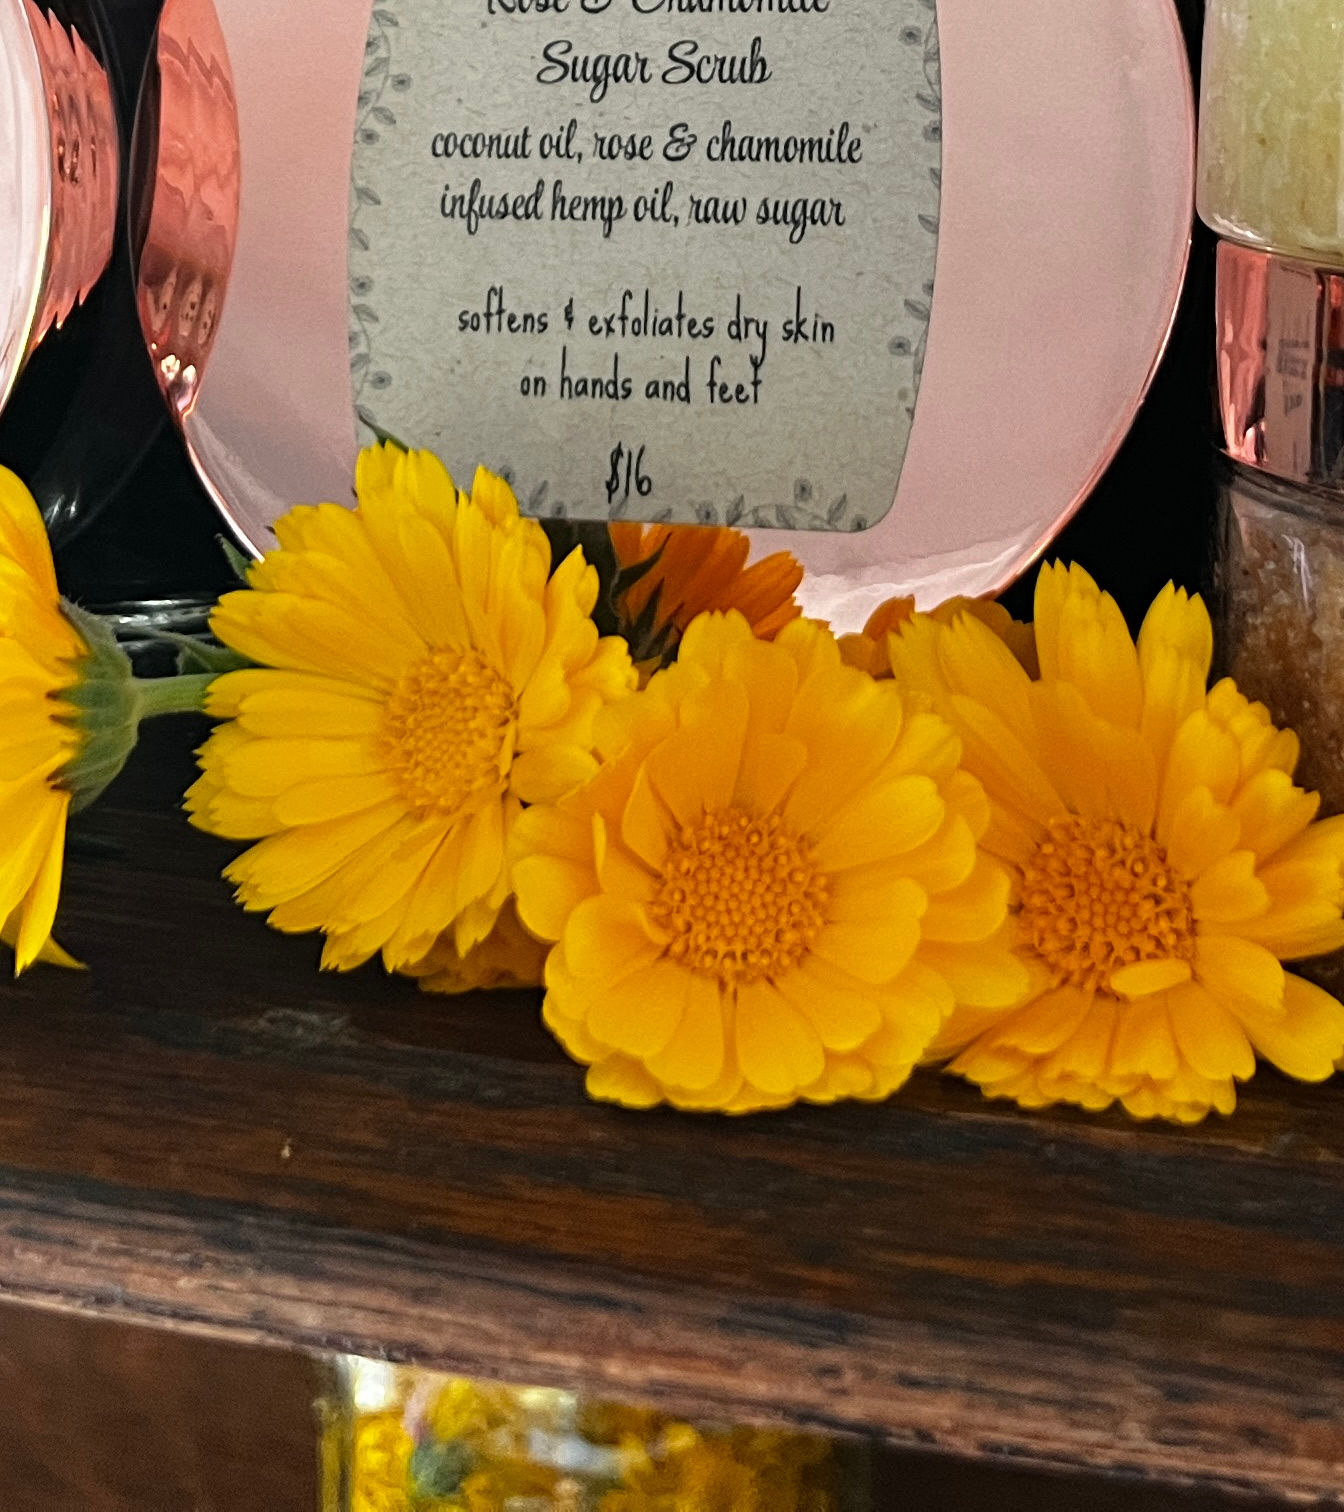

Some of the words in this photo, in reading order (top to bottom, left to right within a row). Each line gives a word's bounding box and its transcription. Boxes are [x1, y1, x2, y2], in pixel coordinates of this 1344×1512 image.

[537, 40, 652, 102] Sugar
[661, 36, 773, 85] Scrub
[430, 125, 532, 160] coconut
[539, 119, 583, 164] oil,
[593, 131, 654, 161] rose
[663, 123, 698, 161] &
[706, 120, 863, 164] chamomile
[440, 179, 545, 234] infused
[551, 182, 628, 237] hemp
[633, 181, 680, 228] oil,
[687, 193, 748, 226] raw
[756, 196, 847, 243] sugar
[458, 287, 548, 334] softens
[588, 288, 715, 339] exfoliates
[726, 295, 768, 362] dry
[782, 287, 835, 345] skin
[520, 374, 546, 398] on
[559, 346, 633, 401] hands
[645, 356, 691, 403] and
[707, 353, 763, 405] feet
[605, 441, 652, 503] $16
